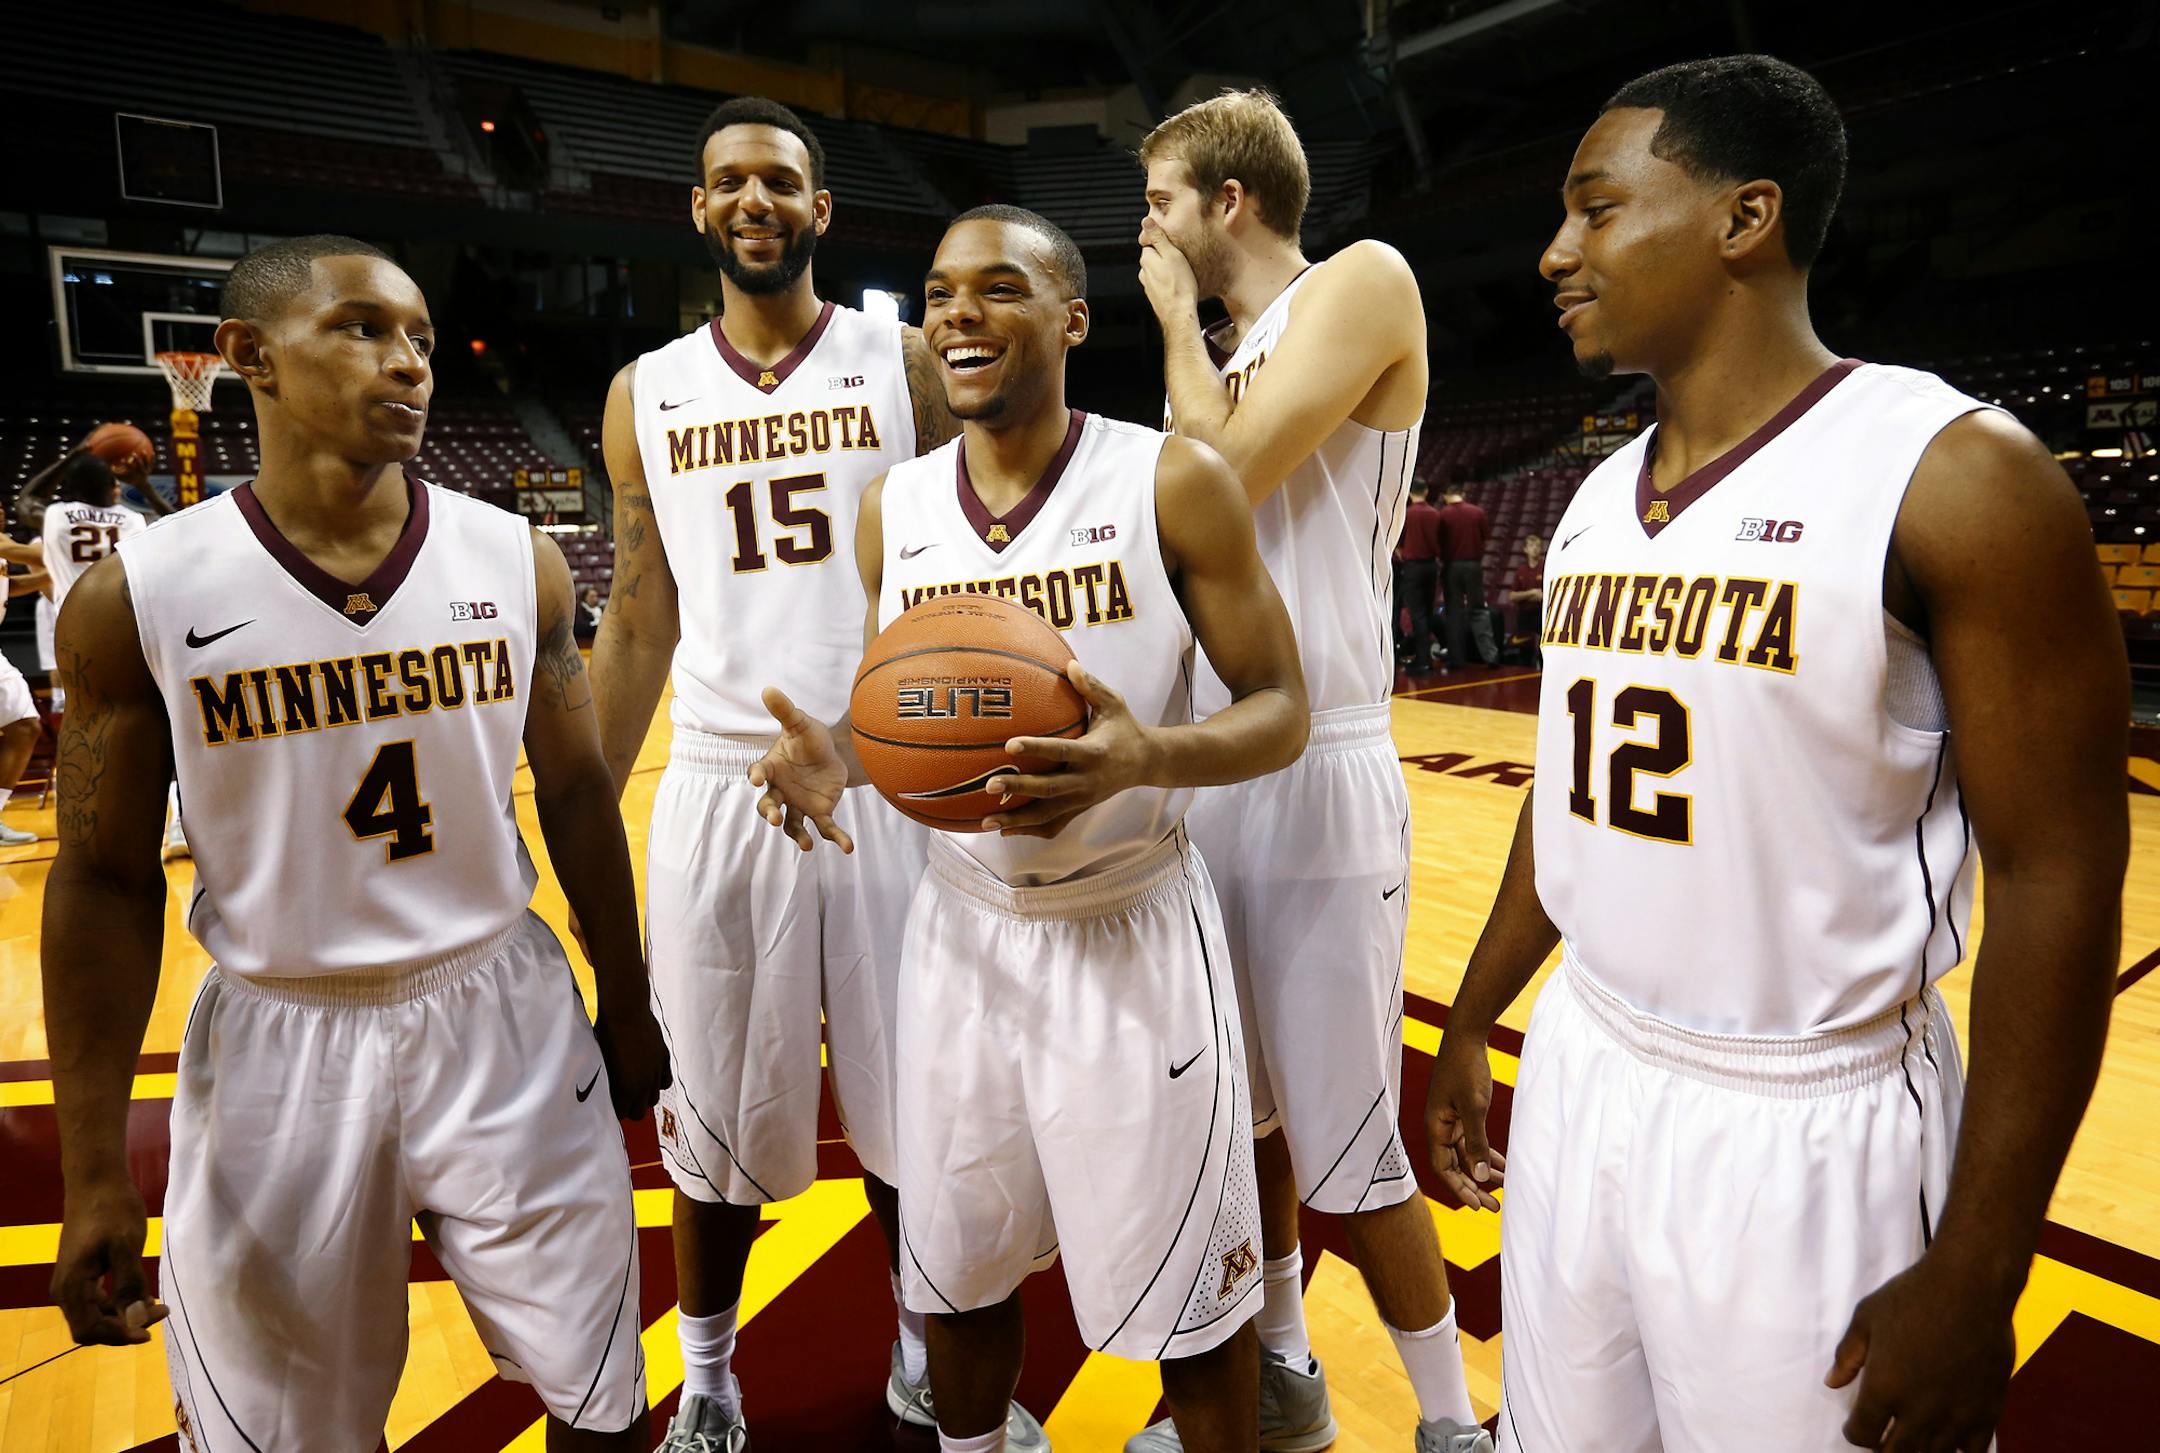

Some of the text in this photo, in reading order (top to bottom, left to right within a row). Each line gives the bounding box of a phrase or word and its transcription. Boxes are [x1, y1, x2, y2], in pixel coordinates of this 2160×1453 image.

[667, 404, 881, 476] MINNESOTA
[65, 509, 126, 525] KONATE
[71, 526, 118, 563] 21
[724, 472, 835, 574] 15
[189, 637, 516, 747] MINNESOTA
[897, 687, 1013, 720] ELITE
[898, 676, 1012, 686] CHAMPIONSHIP
[1566, 675, 1693, 846] 12
[341, 738, 435, 865] 4
